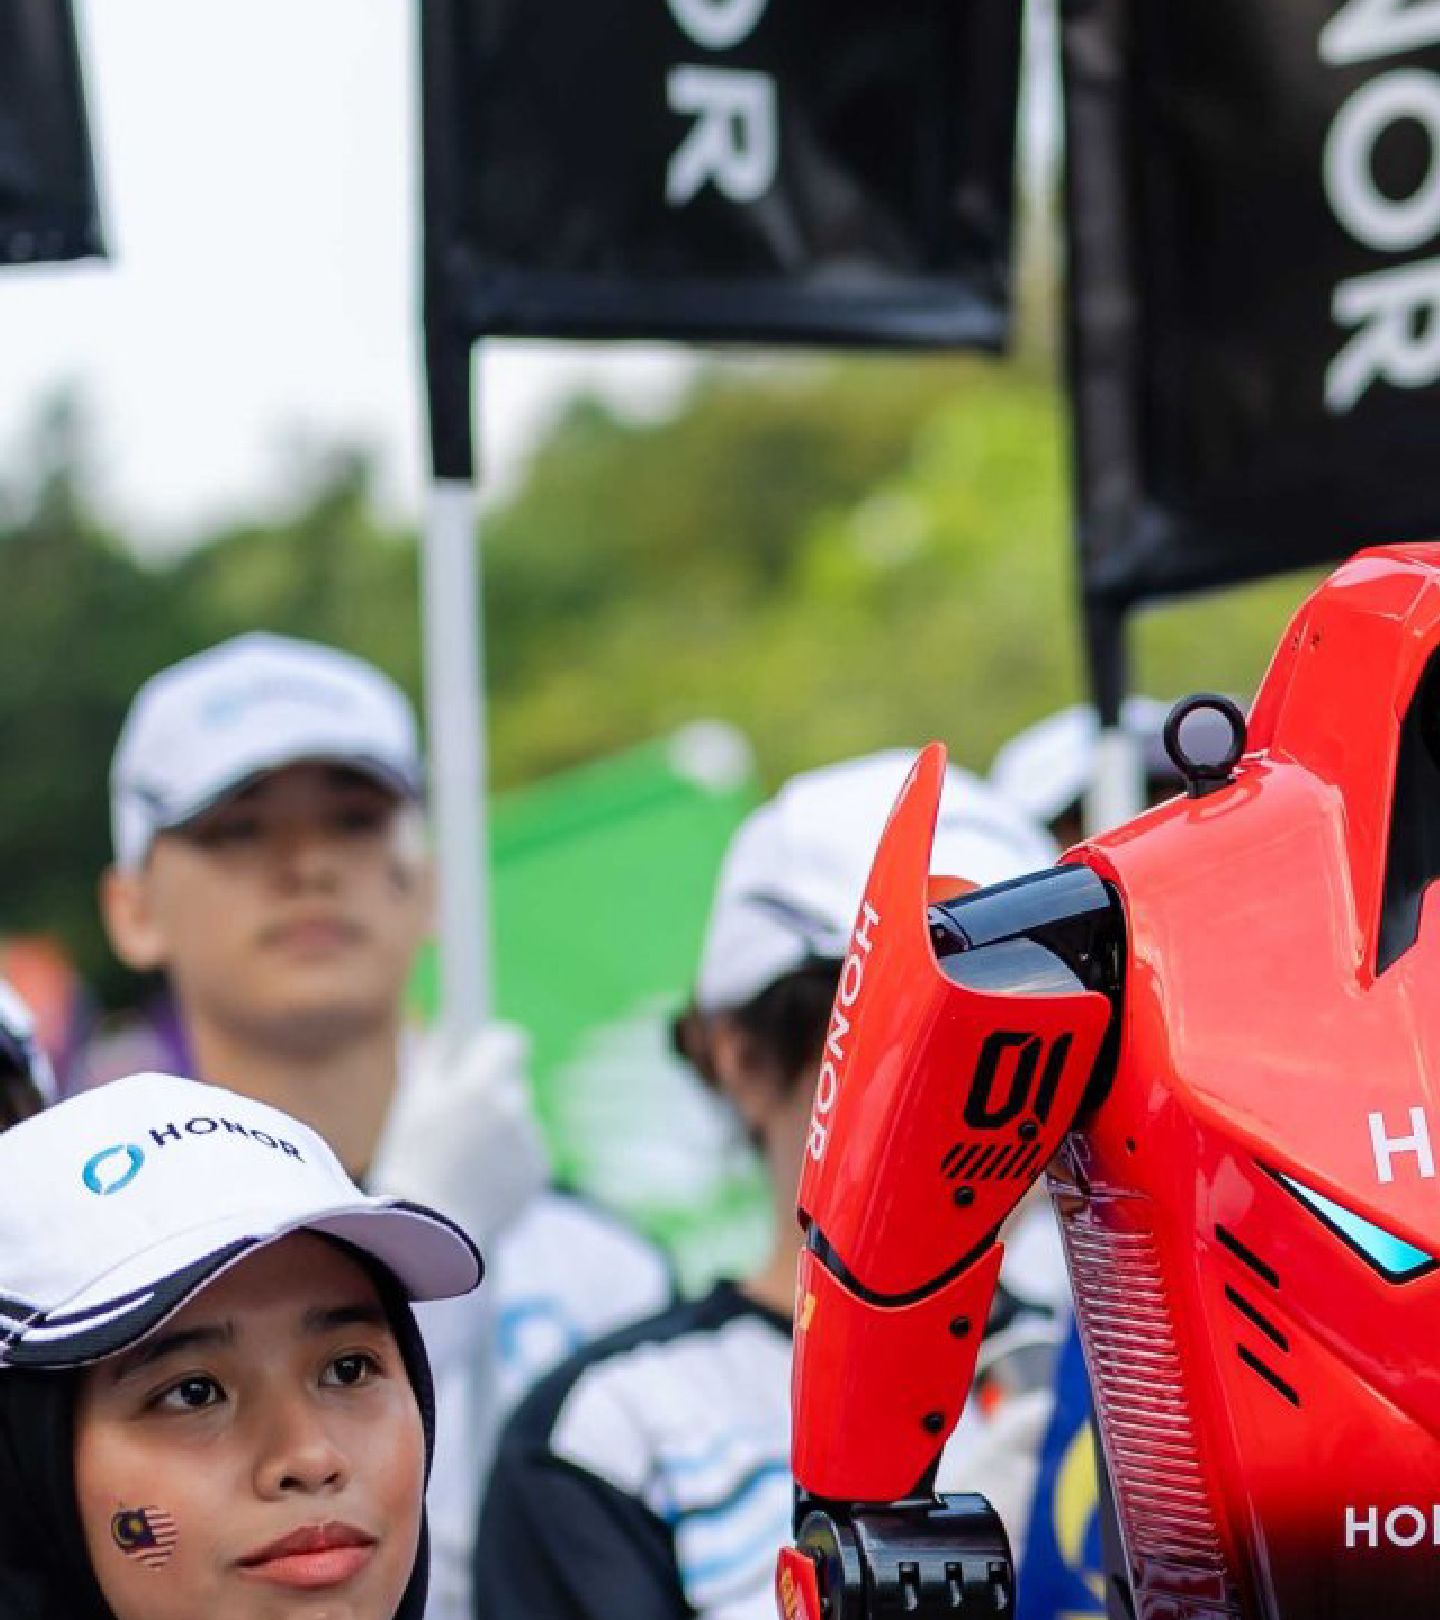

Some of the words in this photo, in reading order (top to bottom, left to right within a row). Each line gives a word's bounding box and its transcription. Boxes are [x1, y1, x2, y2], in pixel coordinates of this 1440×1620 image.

[806, 899, 881, 1164] HONOR
[963, 1030, 1072, 1129] 01
[148, 1116, 307, 1164] HONOR
